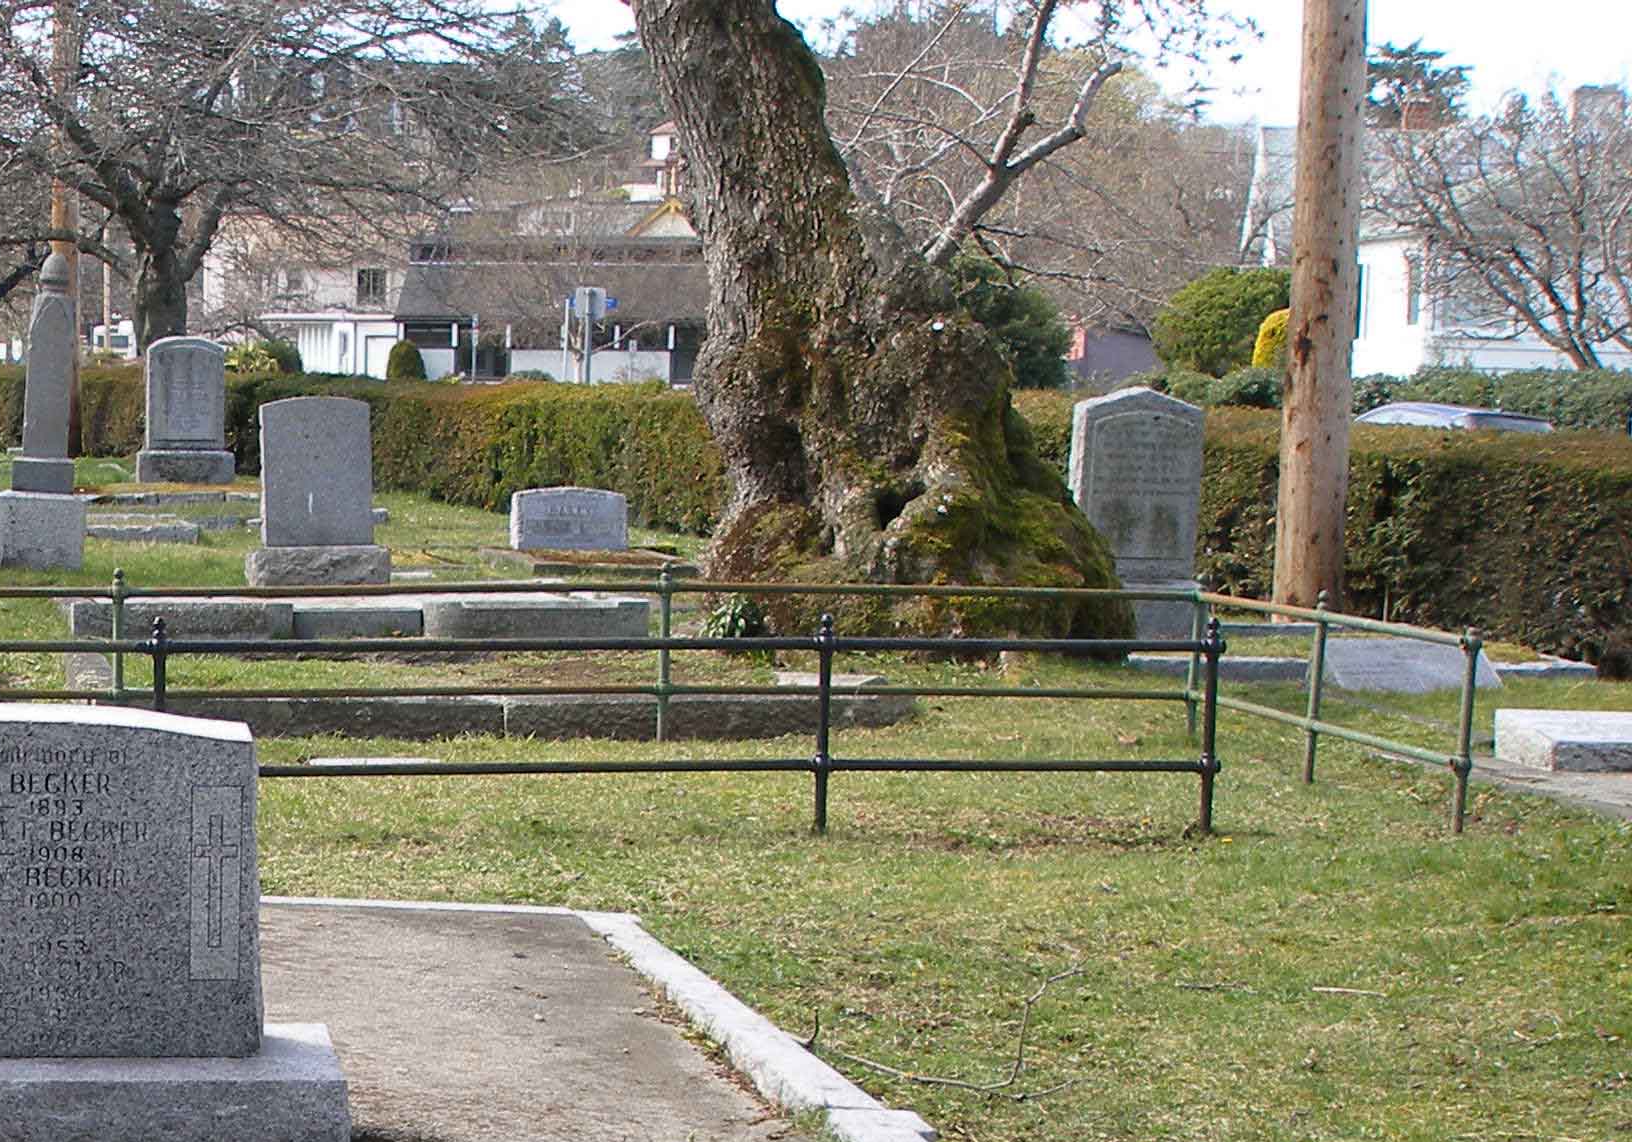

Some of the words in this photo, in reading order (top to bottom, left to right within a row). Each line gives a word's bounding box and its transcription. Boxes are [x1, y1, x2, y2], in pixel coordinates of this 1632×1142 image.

[10, 772, 112, 796] BECKER
[29, 798, 86, 816] 1893
[50, 819, 148, 842] BECKER
[30, 844, 85, 863] 1908
[25, 866, 128, 889] BECKER
